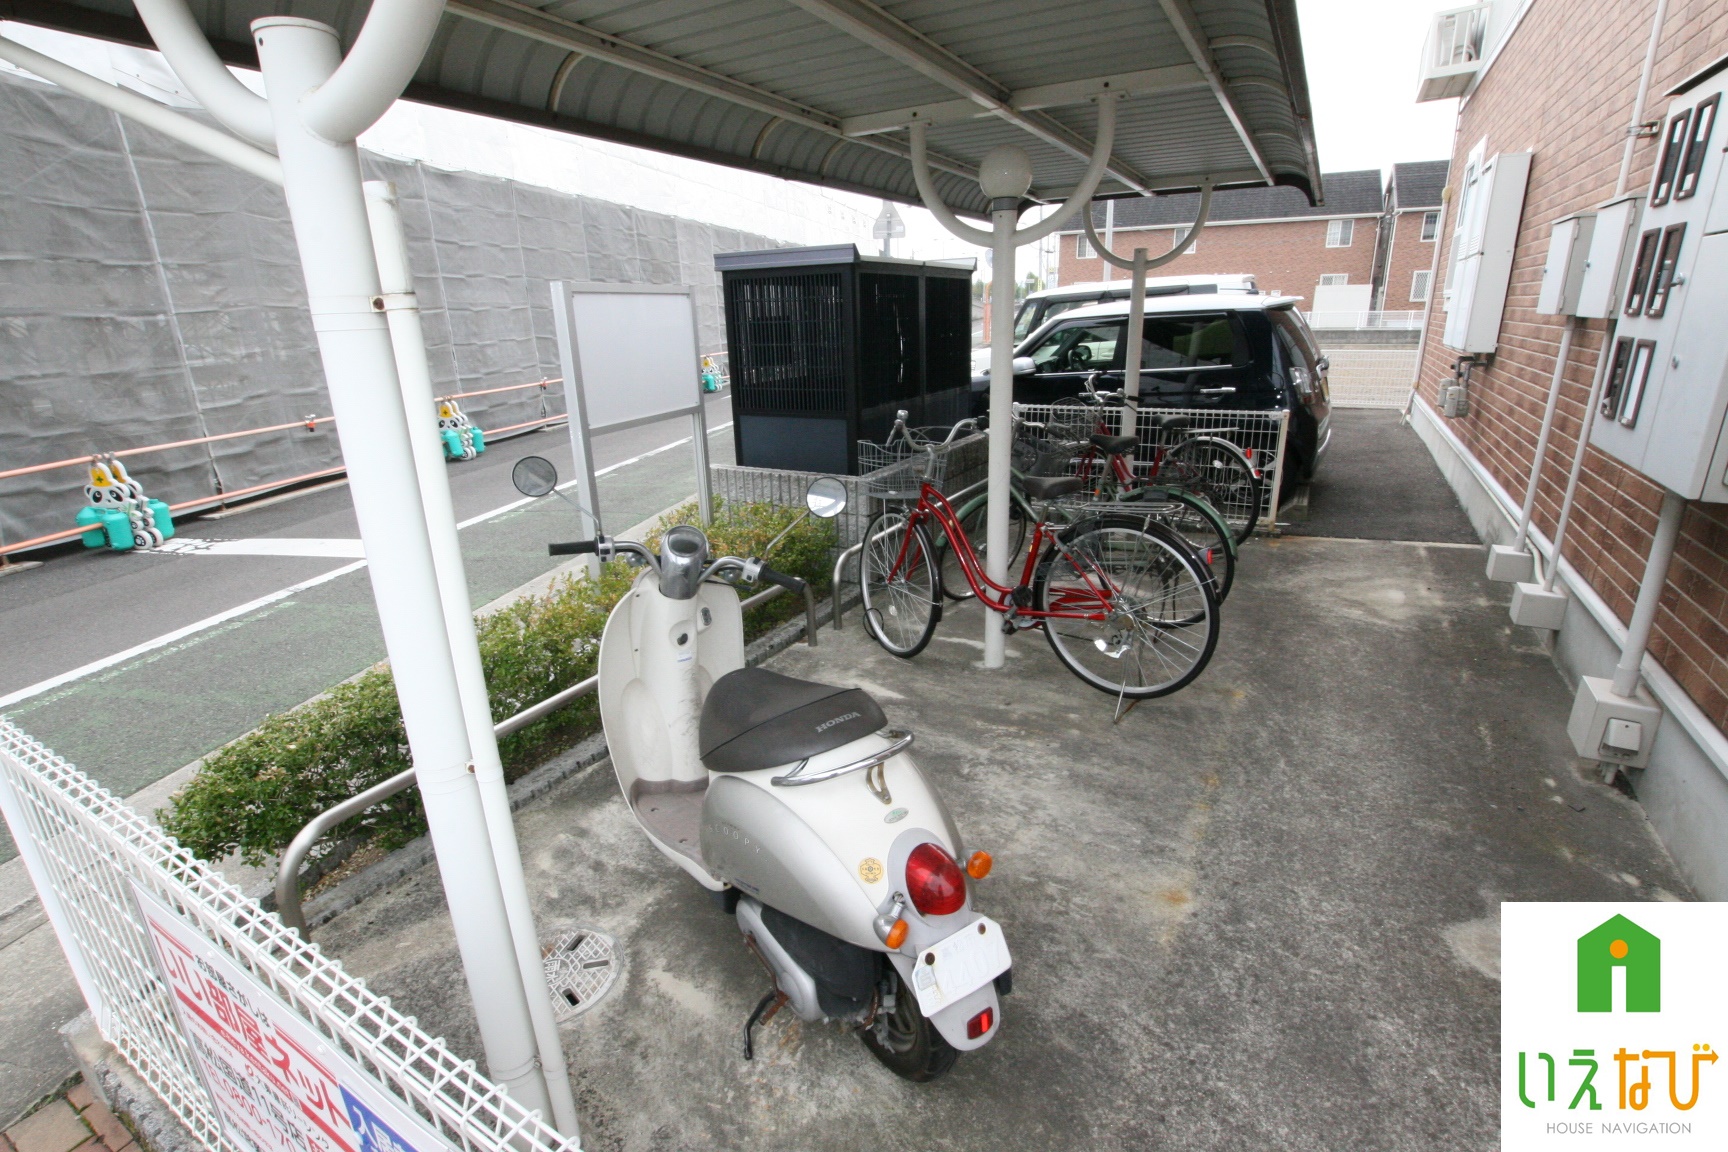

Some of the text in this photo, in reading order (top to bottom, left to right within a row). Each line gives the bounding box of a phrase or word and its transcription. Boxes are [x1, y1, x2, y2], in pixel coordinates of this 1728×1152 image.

[815, 711, 862, 733] HONDA
[195, 955, 271, 1028] お部屋さがしは
[154, 934, 351, 1129] いい部屋ネット
